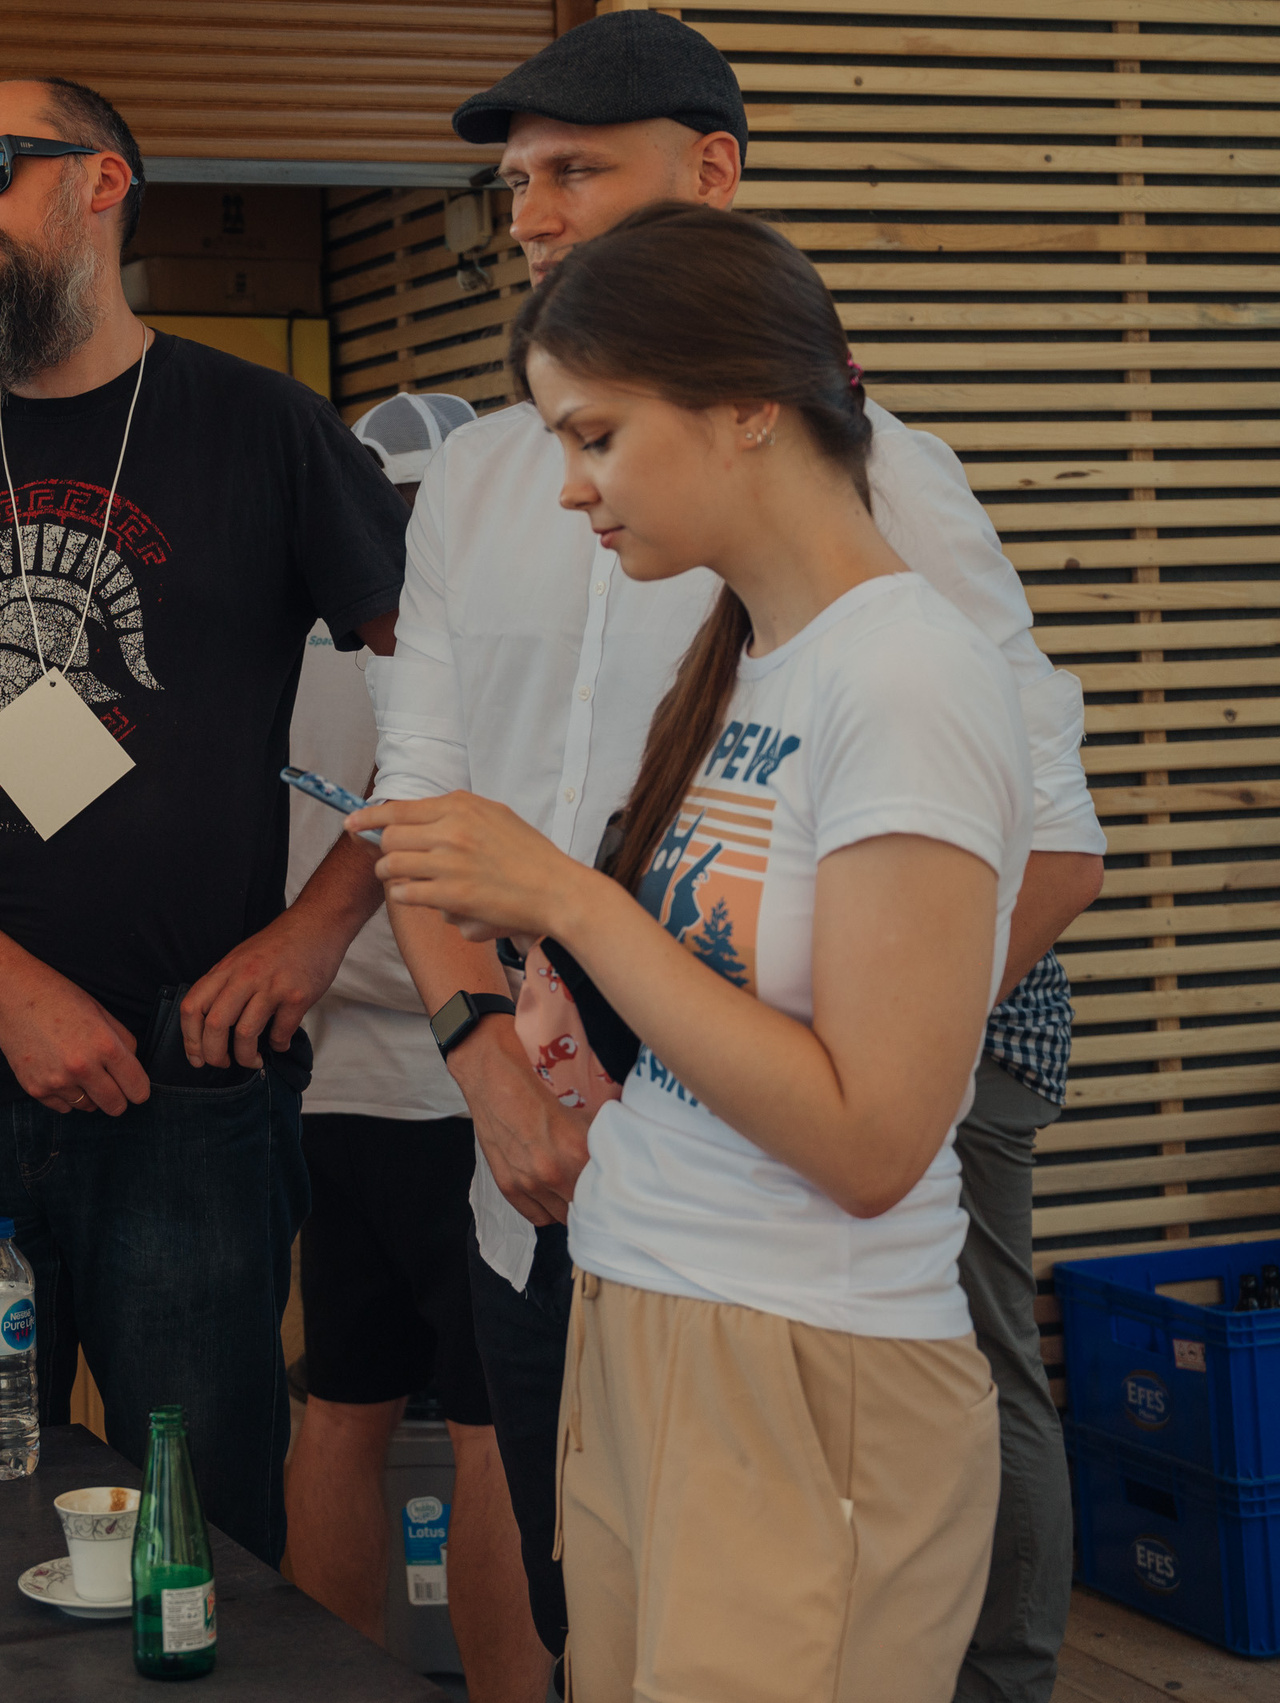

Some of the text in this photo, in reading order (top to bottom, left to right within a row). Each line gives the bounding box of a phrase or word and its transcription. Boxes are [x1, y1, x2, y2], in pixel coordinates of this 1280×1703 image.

[704, 720, 801, 786] PEW
[4, 1319, 25, 1332] Pure
[1126, 1380, 1165, 1414] EFES
[407, 1526, 446, 1539] Lotus
[1136, 1543, 1175, 1579] EFES
